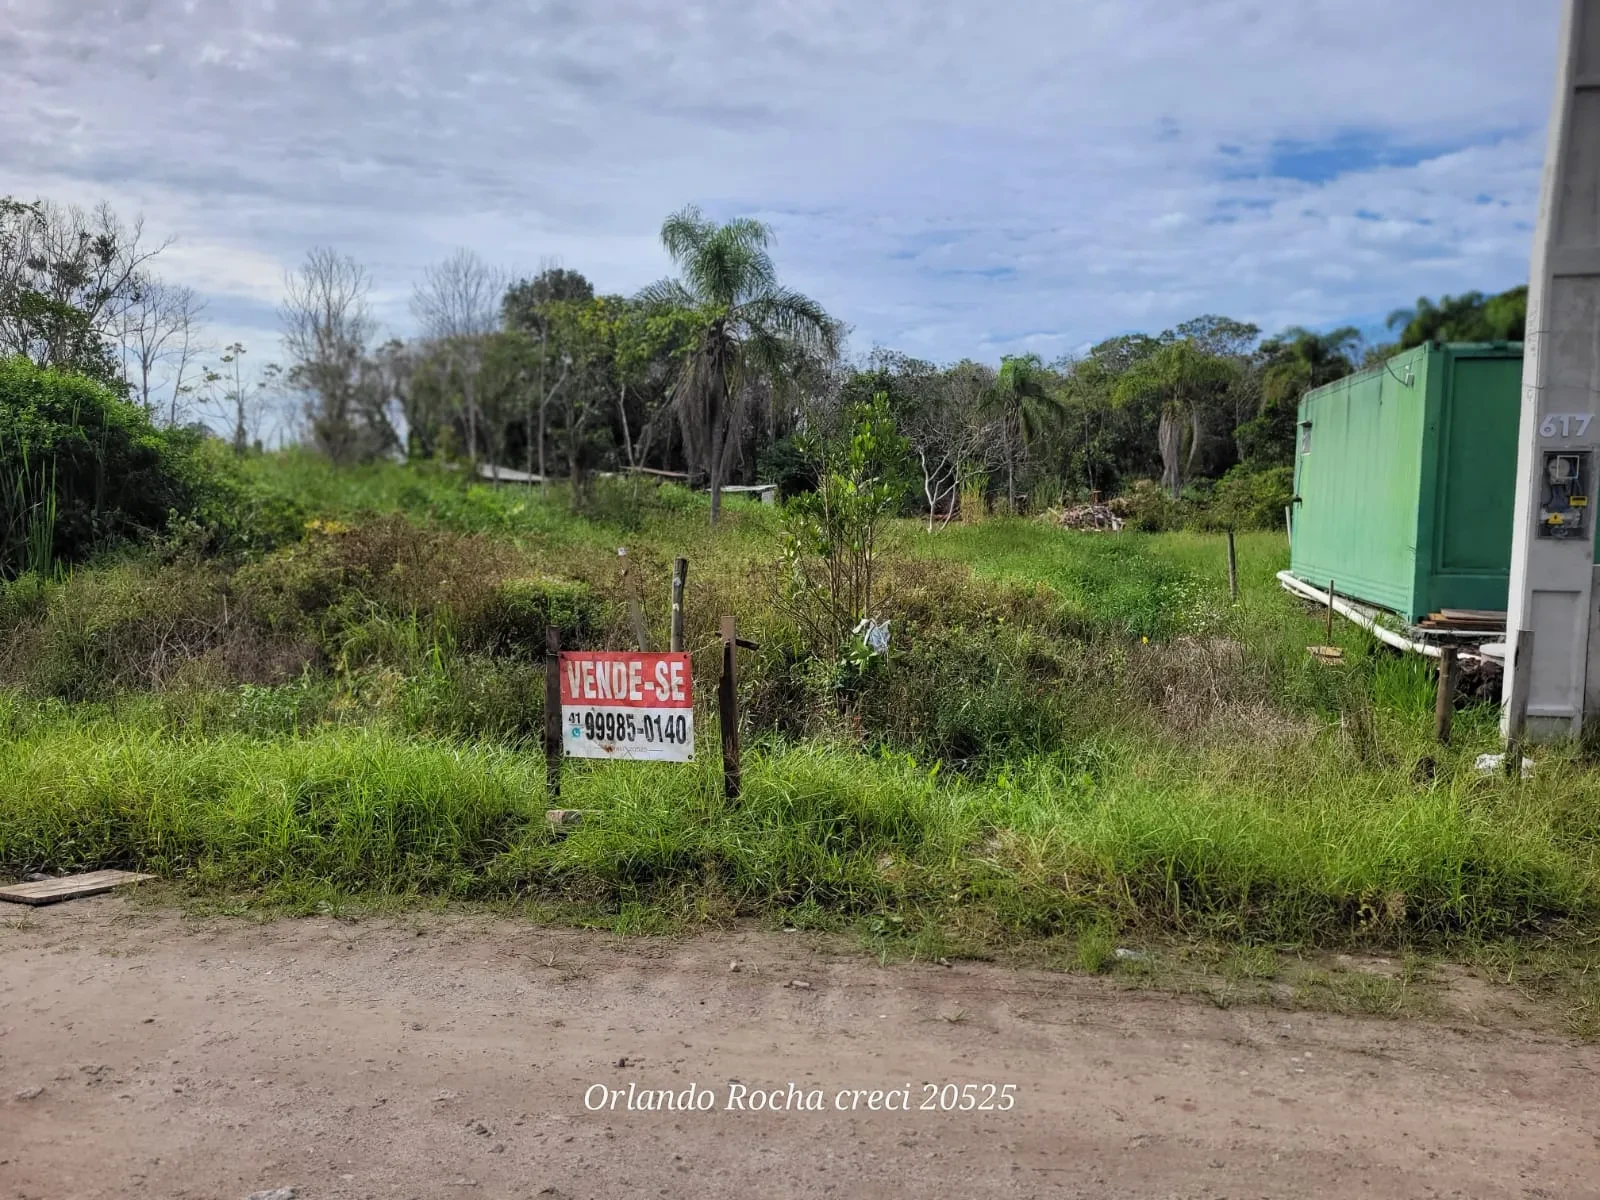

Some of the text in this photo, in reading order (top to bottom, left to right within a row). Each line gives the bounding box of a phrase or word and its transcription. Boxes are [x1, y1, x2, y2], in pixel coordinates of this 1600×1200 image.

[1539, 414, 1594, 438] 617
[567, 660, 686, 701] VENDE-SE
[568, 711, 687, 744] 41 99985-0140
